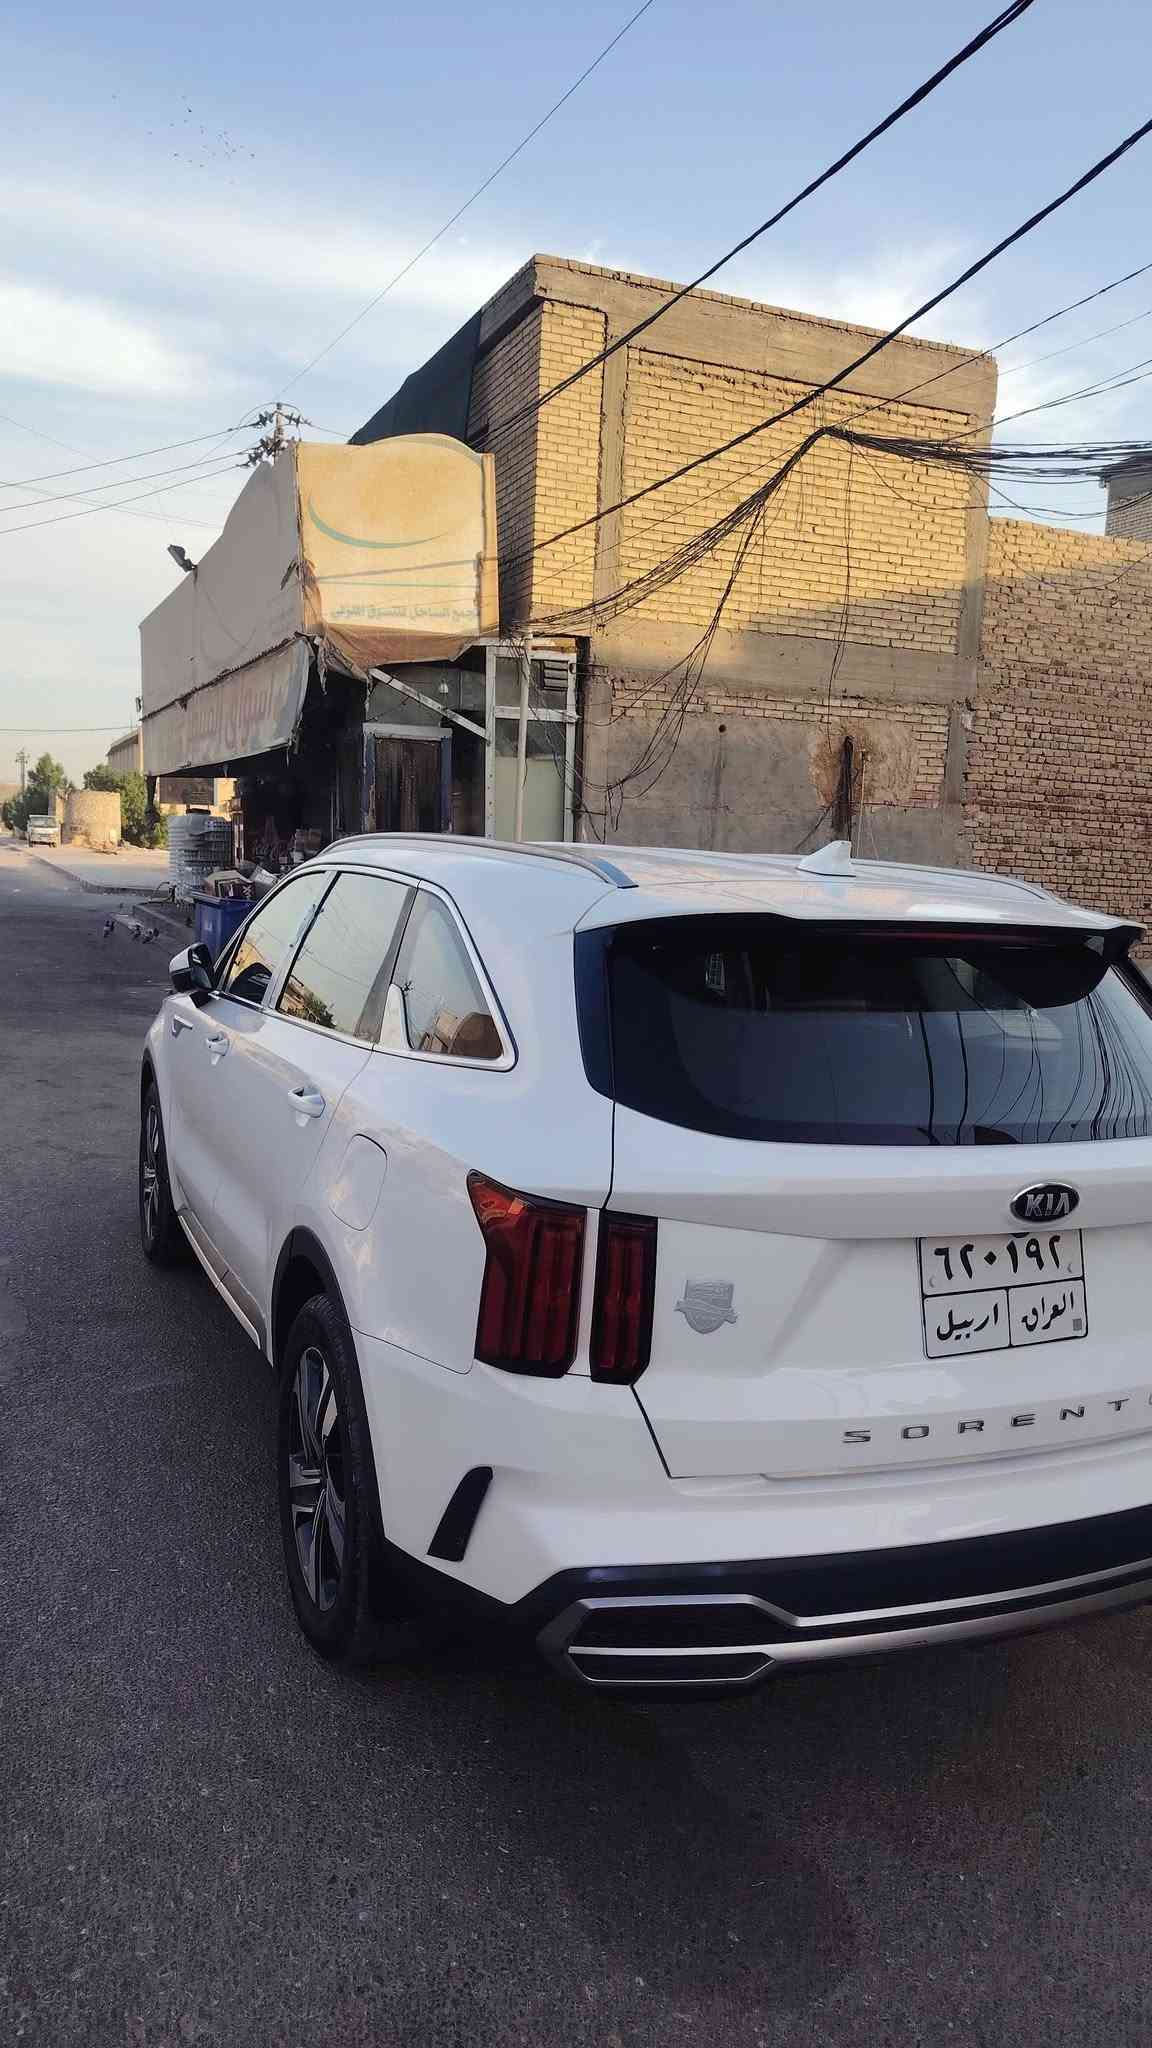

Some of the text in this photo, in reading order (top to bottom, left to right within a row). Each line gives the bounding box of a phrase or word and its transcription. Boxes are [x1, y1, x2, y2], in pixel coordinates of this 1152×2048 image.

[1024, 1192, 1071, 1217] KIA
[933, 1234, 1062, 1281] ٦٢٠١٩٢
[936, 1302, 999, 1341] اربيل
[1021, 1291, 1075, 1332] العراق
[842, 1392, 1152, 1444] SORENT
